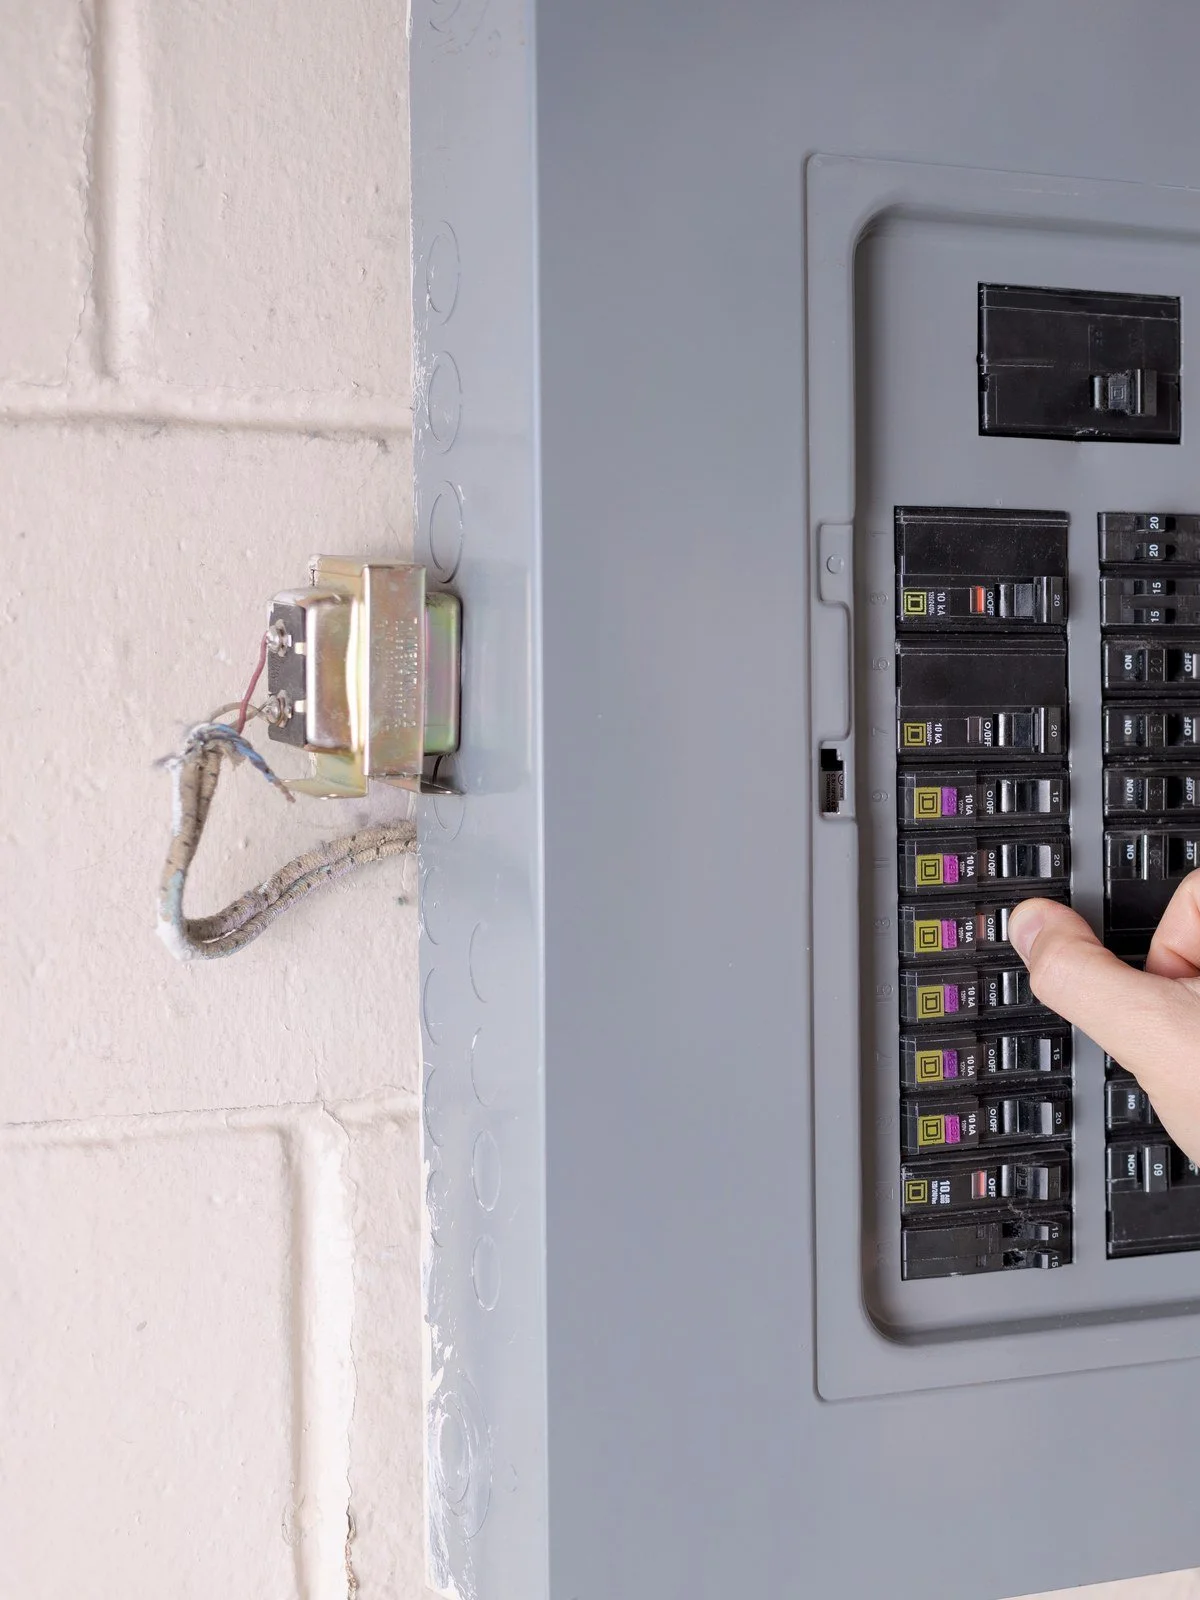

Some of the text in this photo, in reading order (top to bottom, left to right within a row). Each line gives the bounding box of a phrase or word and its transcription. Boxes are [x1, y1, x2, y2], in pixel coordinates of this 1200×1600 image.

[1150, 516, 1159, 529] 20
[1149, 544, 1158, 556] 20
[1153, 582, 1161, 594] 15
[937, 592, 945, 616] 10 kA
[1053, 595, 1061, 607] 20
[1151, 611, 1159, 622] 15
[1124, 654, 1132, 670] ON
[1051, 725, 1058, 737] 20
[1124, 720, 1132, 735] ON
[1184, 717, 1192, 736] OFF
[934, 723, 943, 745] 10 kA
[1052, 791, 1059, 803] 15
[965, 794, 973, 816] 10 kA
[1127, 845, 1134, 860] ON
[1186, 841, 1194, 860] OFF
[967, 856, 974, 877] 10 kA
[1053, 855, 1060, 867] 20
[965, 921, 973, 943] 10 kA
[968, 986, 976, 1007] 10 kA
[1053, 1048, 1060, 1060] 15
[967, 1055, 975, 1076] 10 kA
[1128, 1095, 1136, 1109] ON
[969, 1114, 976, 1135] 10 kA
[1055, 1112, 1062, 1124] 20
[1154, 1163, 1163, 1176] 60
[988, 1178, 996, 1198] OFF
[1051, 1227, 1059, 1239] 15
[1051, 1256, 1059, 1268] 15
